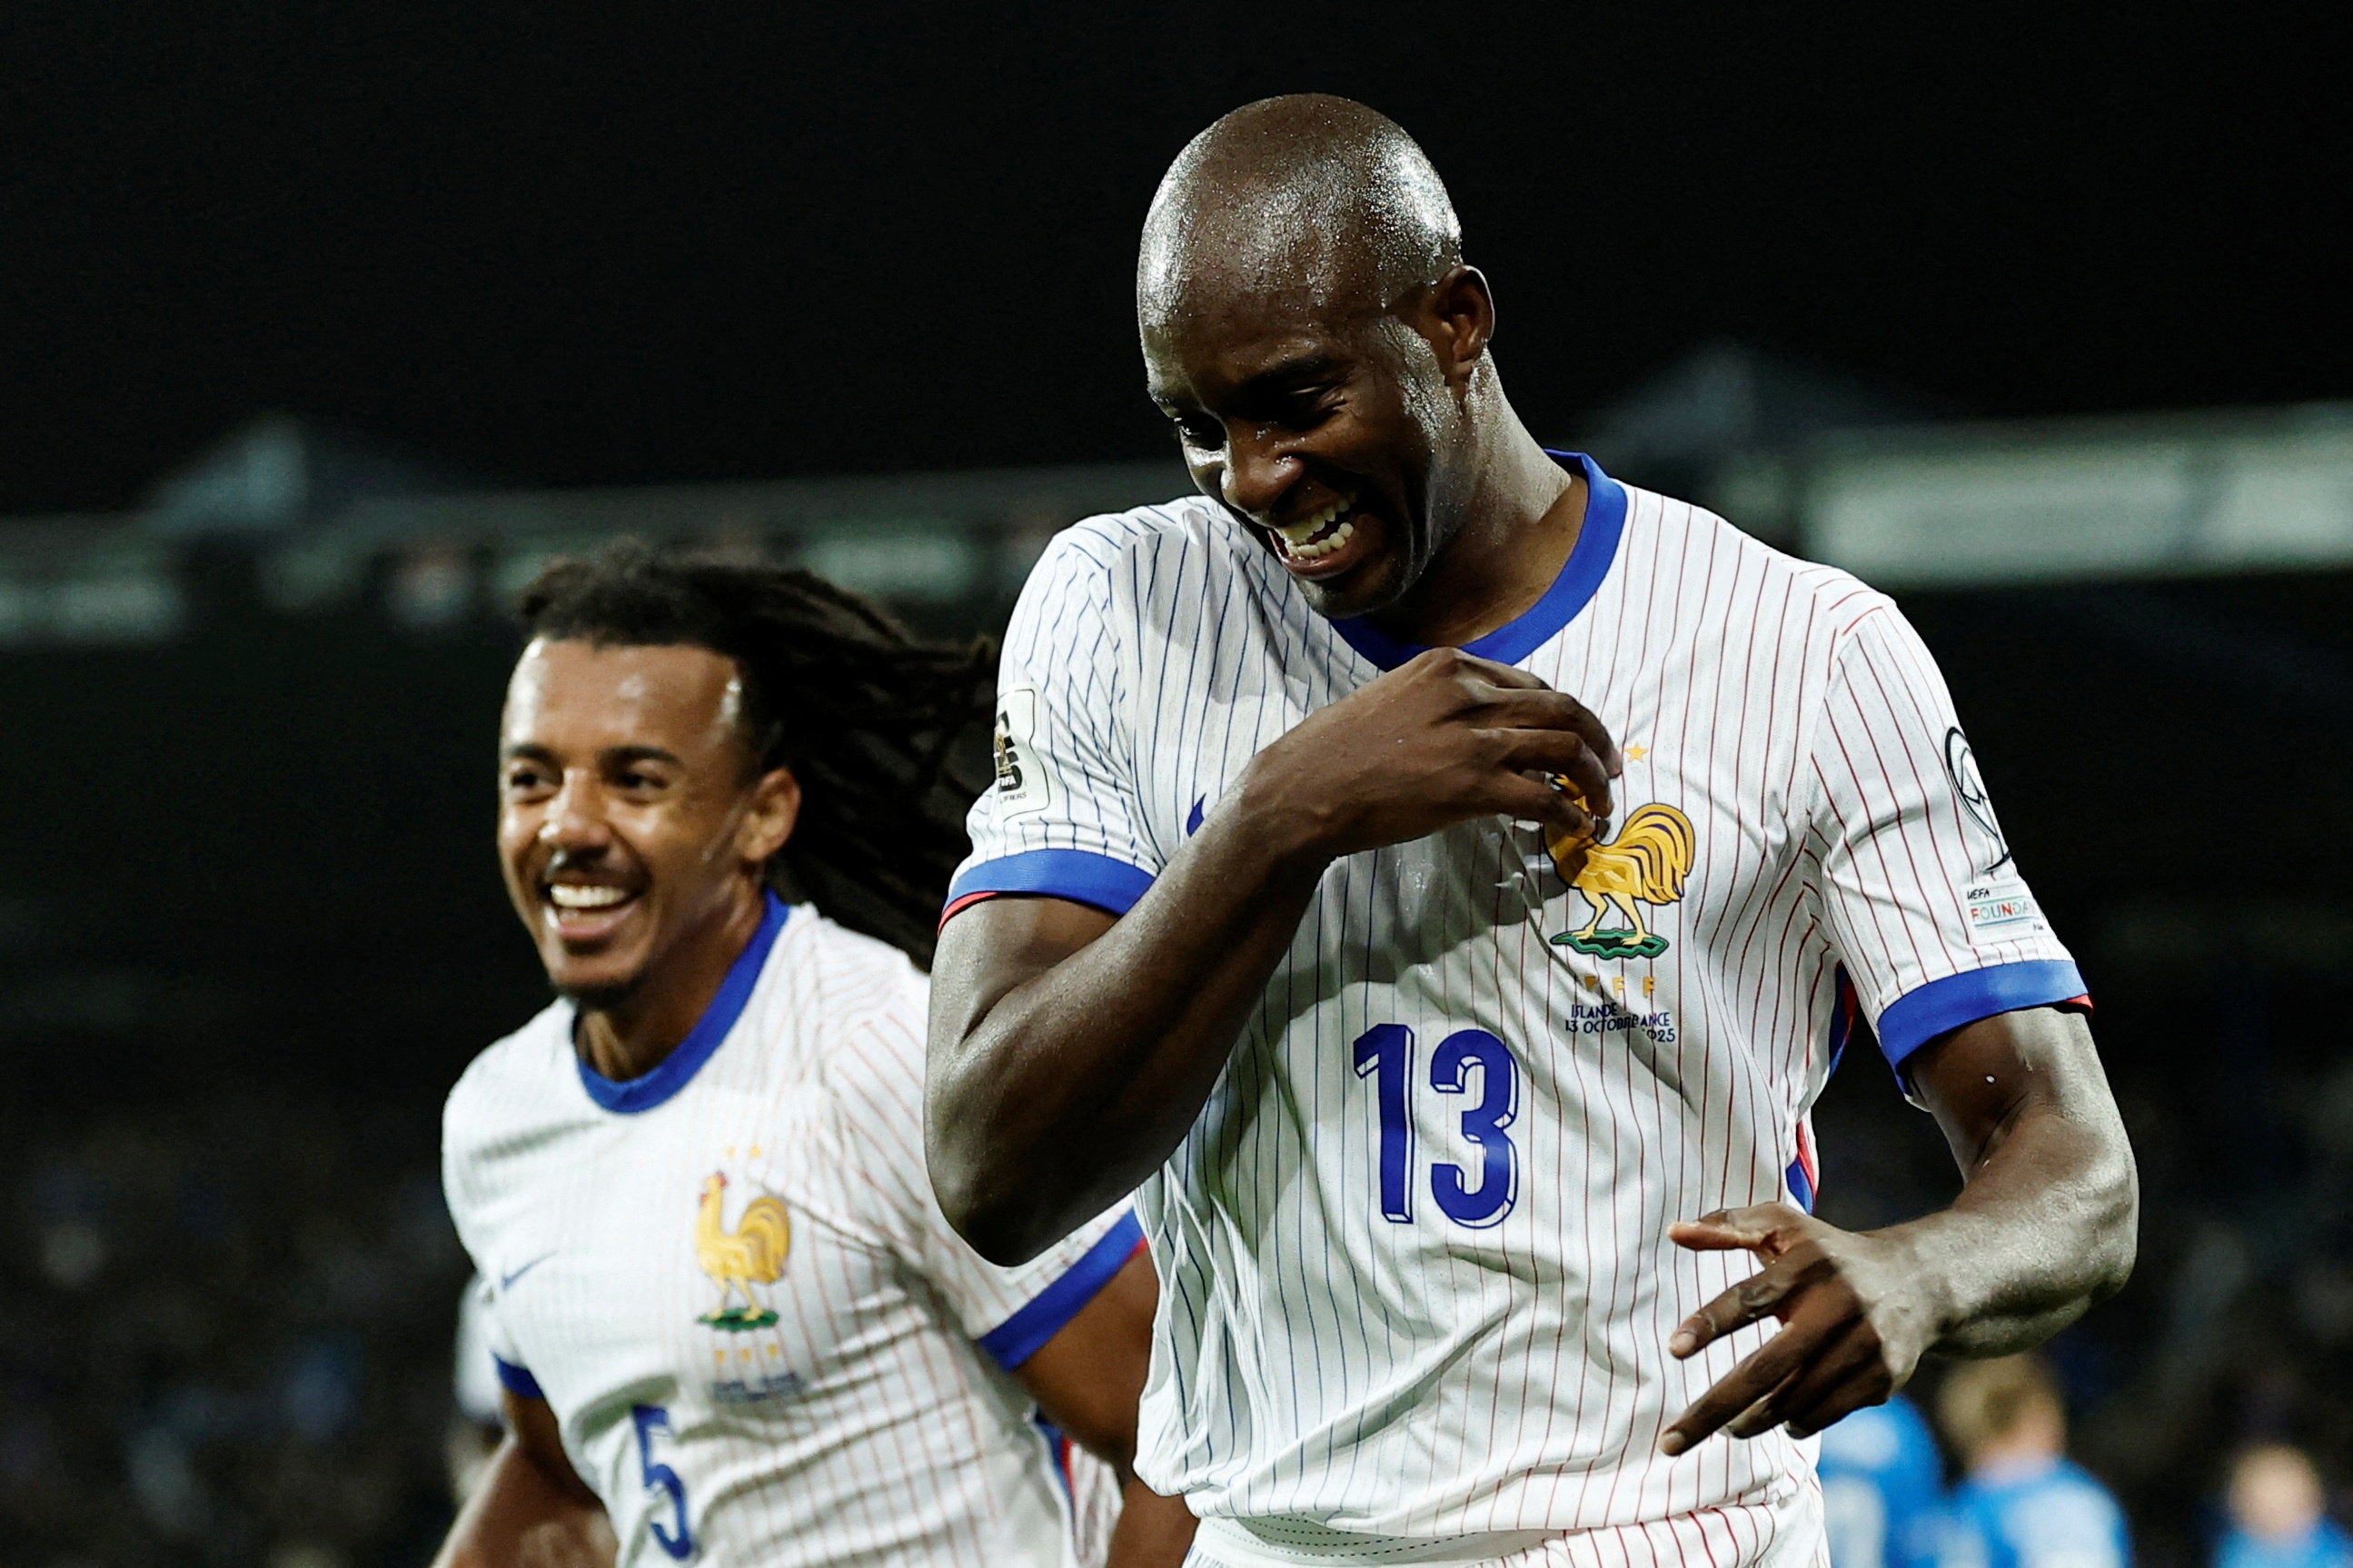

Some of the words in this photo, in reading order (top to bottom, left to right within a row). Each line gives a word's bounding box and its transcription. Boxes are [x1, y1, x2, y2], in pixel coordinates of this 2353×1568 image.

[1967, 888, 1990, 900] UEFA
[1571, 1002, 1617, 1018] ISLANDE
[1564, 1019, 1578, 1033] 13
[1642, 1027, 1675, 1043] 025
[1353, 1023, 1519, 1229] 13
[632, 1404, 694, 1560] 5
